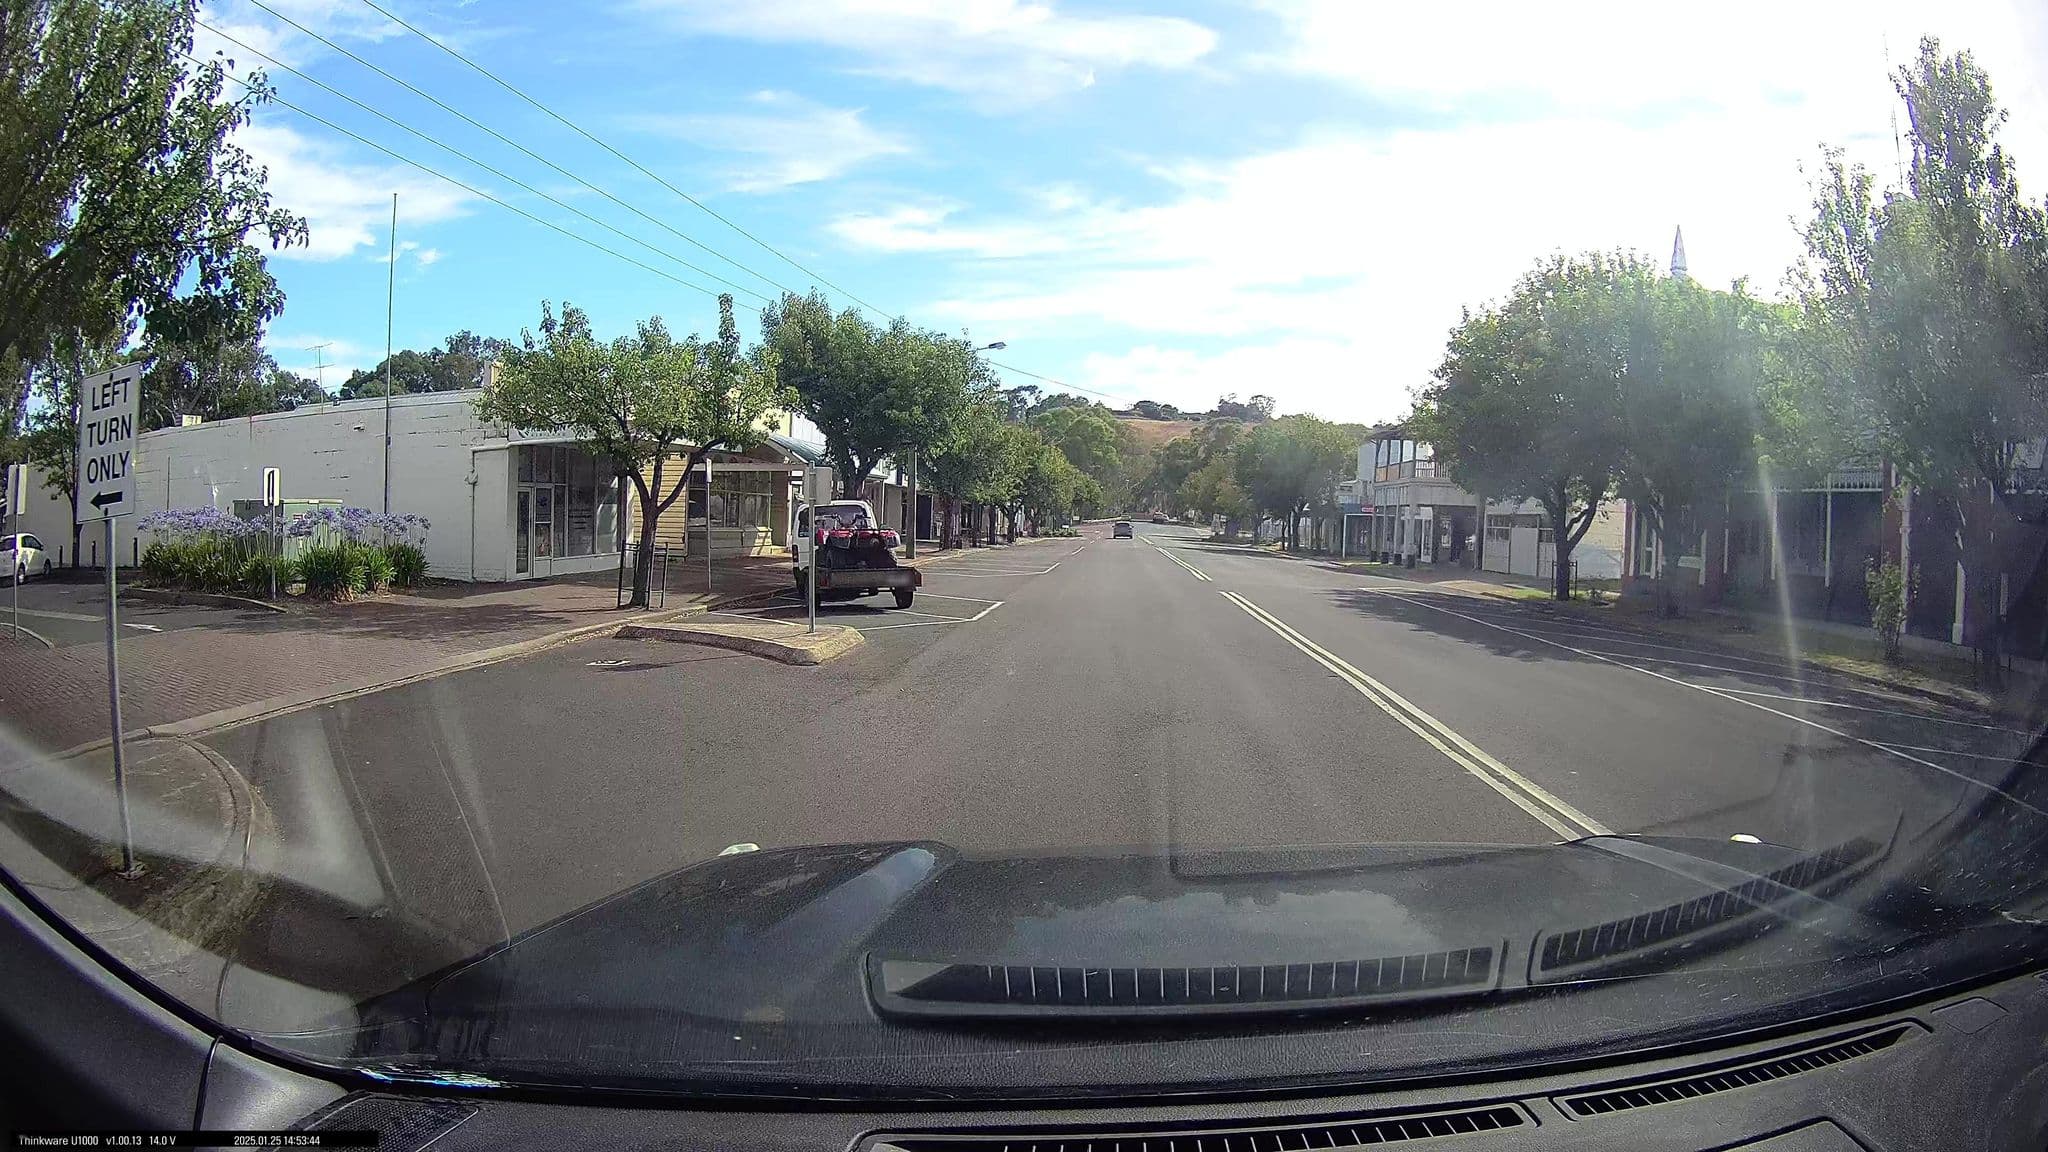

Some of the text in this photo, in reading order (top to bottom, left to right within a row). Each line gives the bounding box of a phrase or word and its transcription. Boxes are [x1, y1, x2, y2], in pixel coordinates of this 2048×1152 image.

[92, 377, 131, 411] LEFT
[87, 413, 132, 448] TURN
[87, 450, 131, 484] ONLY
